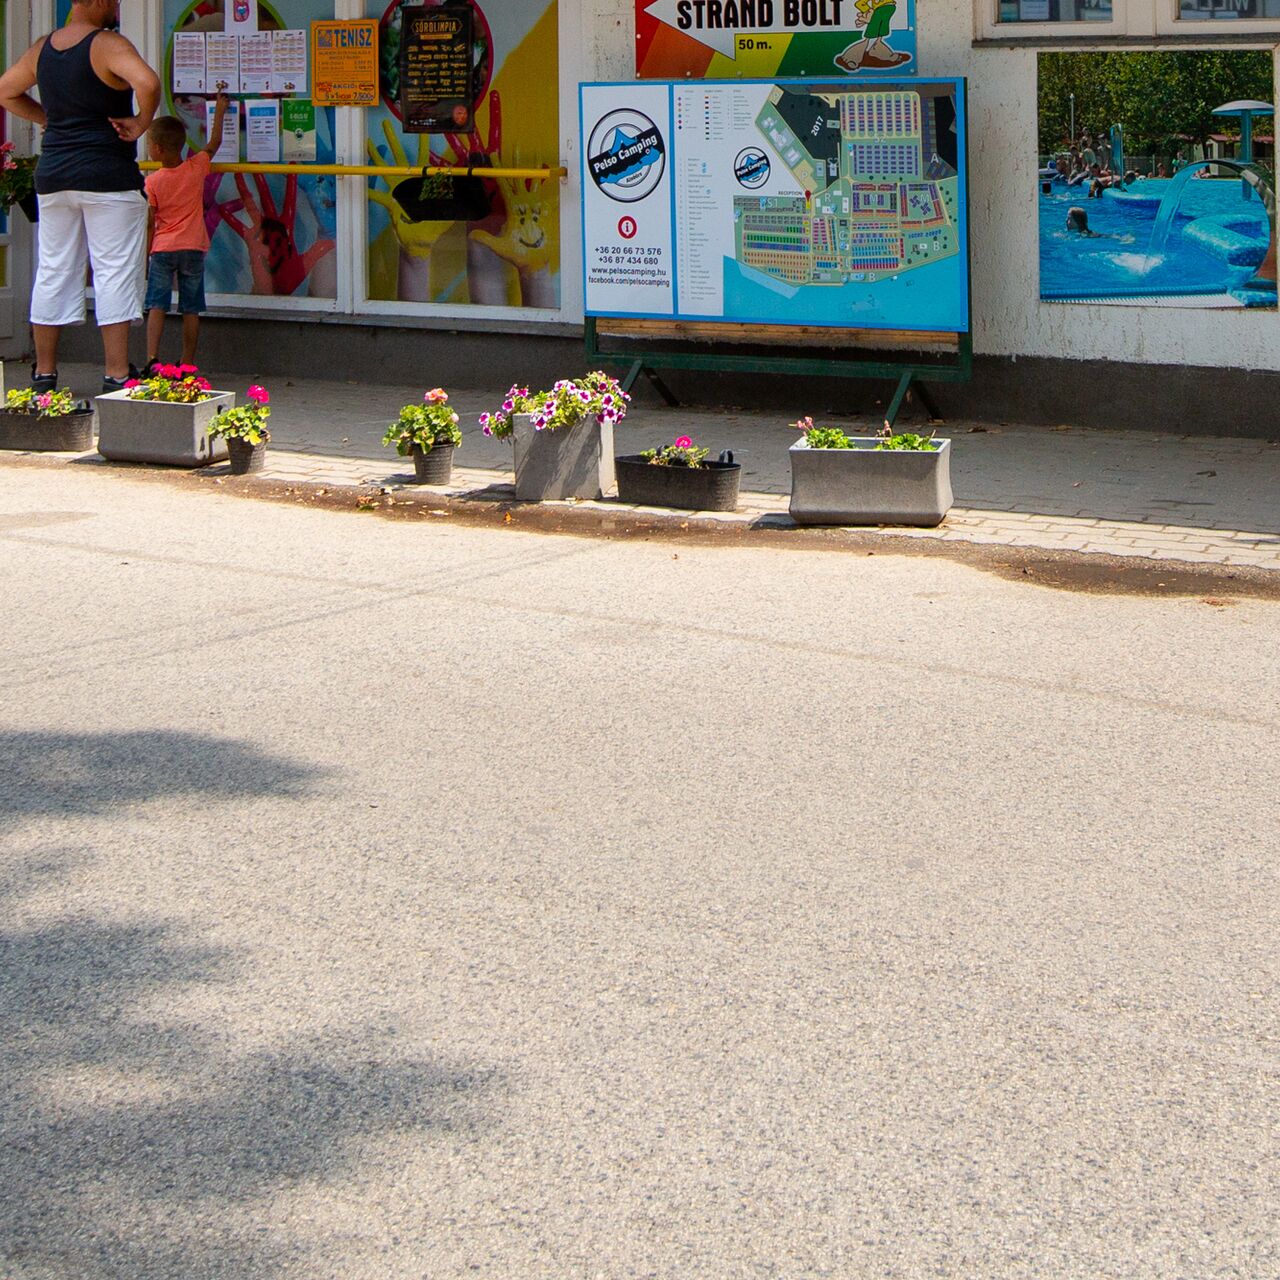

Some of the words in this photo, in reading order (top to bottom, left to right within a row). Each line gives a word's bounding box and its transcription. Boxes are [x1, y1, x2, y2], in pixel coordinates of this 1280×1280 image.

[334, 28, 372, 48] TENISZ
[738, 39, 754, 50] 50
[756, 40, 772, 50] m.
[810, 115, 824, 137] 2017
[593, 154, 617, 173] Pelso
[618, 134, 658, 160] Camping
[930, 153, 940, 164] A
[594, 246, 609, 254] +36
[611, 246, 621, 254] 20
[623, 247, 633, 255] 66
[635, 247, 645, 255] 73
[647, 247, 662, 256] 576
[598, 256, 613, 264] +36
[627, 257, 641, 265] 434
[643, 257, 658, 265] 680
[591, 266, 666, 277] www.pelsocamping.hu
[588, 276, 670, 288] facebook.com/pelsocamping
